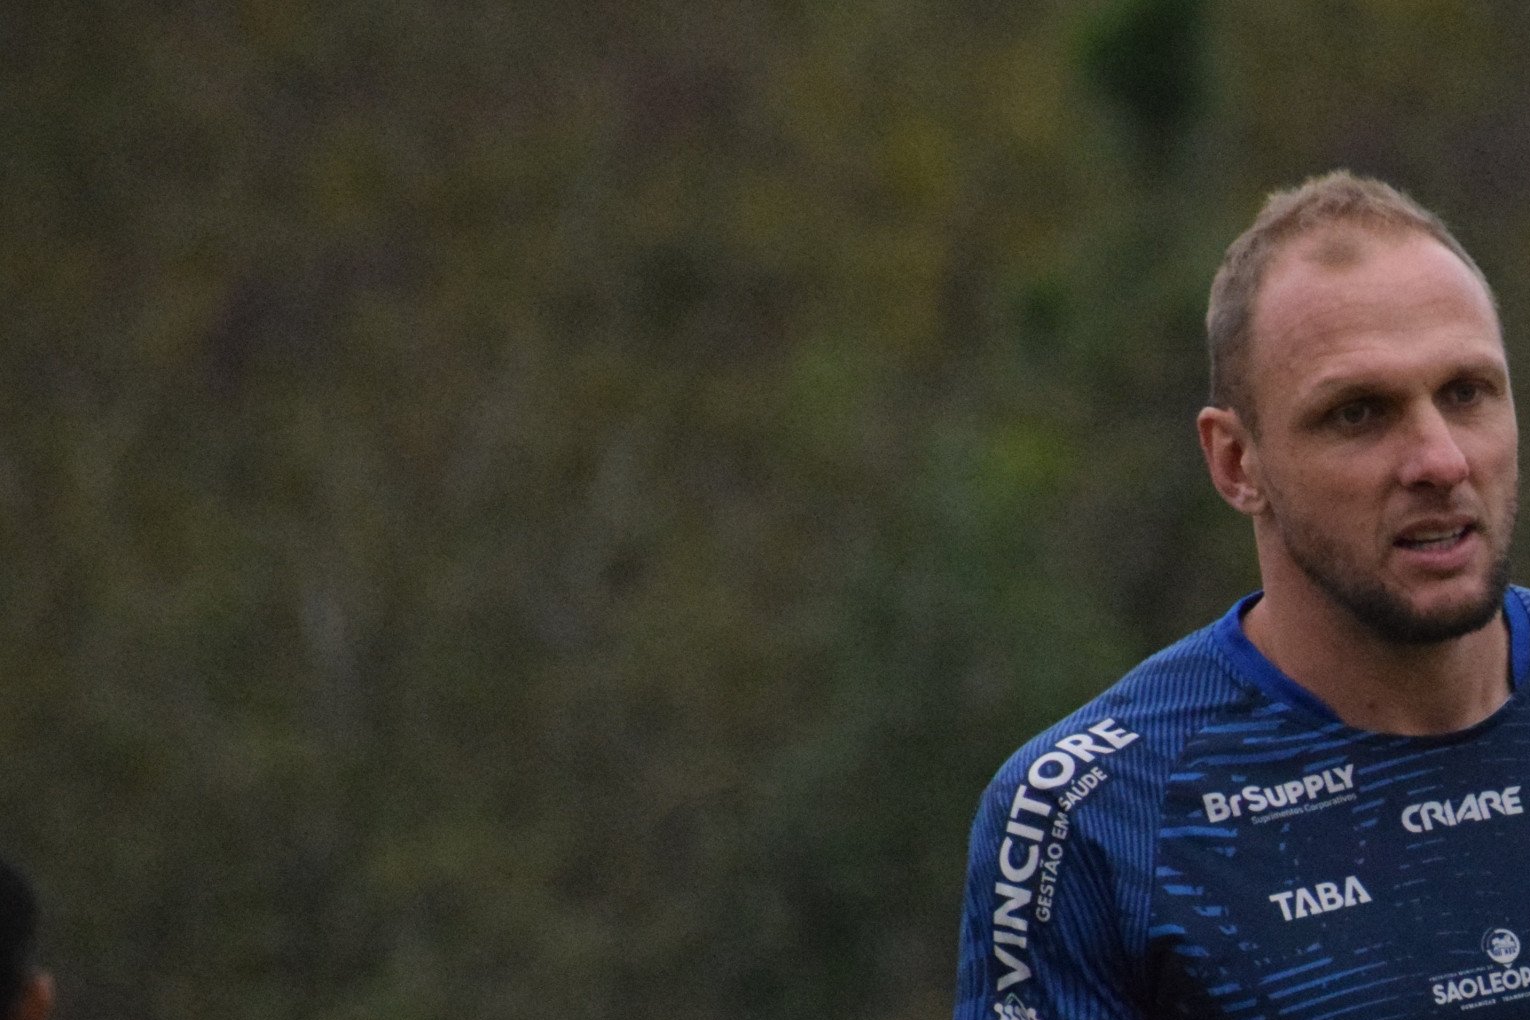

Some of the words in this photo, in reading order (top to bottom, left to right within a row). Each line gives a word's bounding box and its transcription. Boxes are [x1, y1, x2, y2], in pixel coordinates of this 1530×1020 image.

[1058, 766, 1109, 812] SAÚDE
[1401, 785, 1525, 834] CRIARE
[1051, 811, 1072, 841] EM
[993, 718, 1140, 992] VINCITORE
[1036, 841, 1064, 923] GESTÃO
[1269, 875, 1373, 922] TABA
